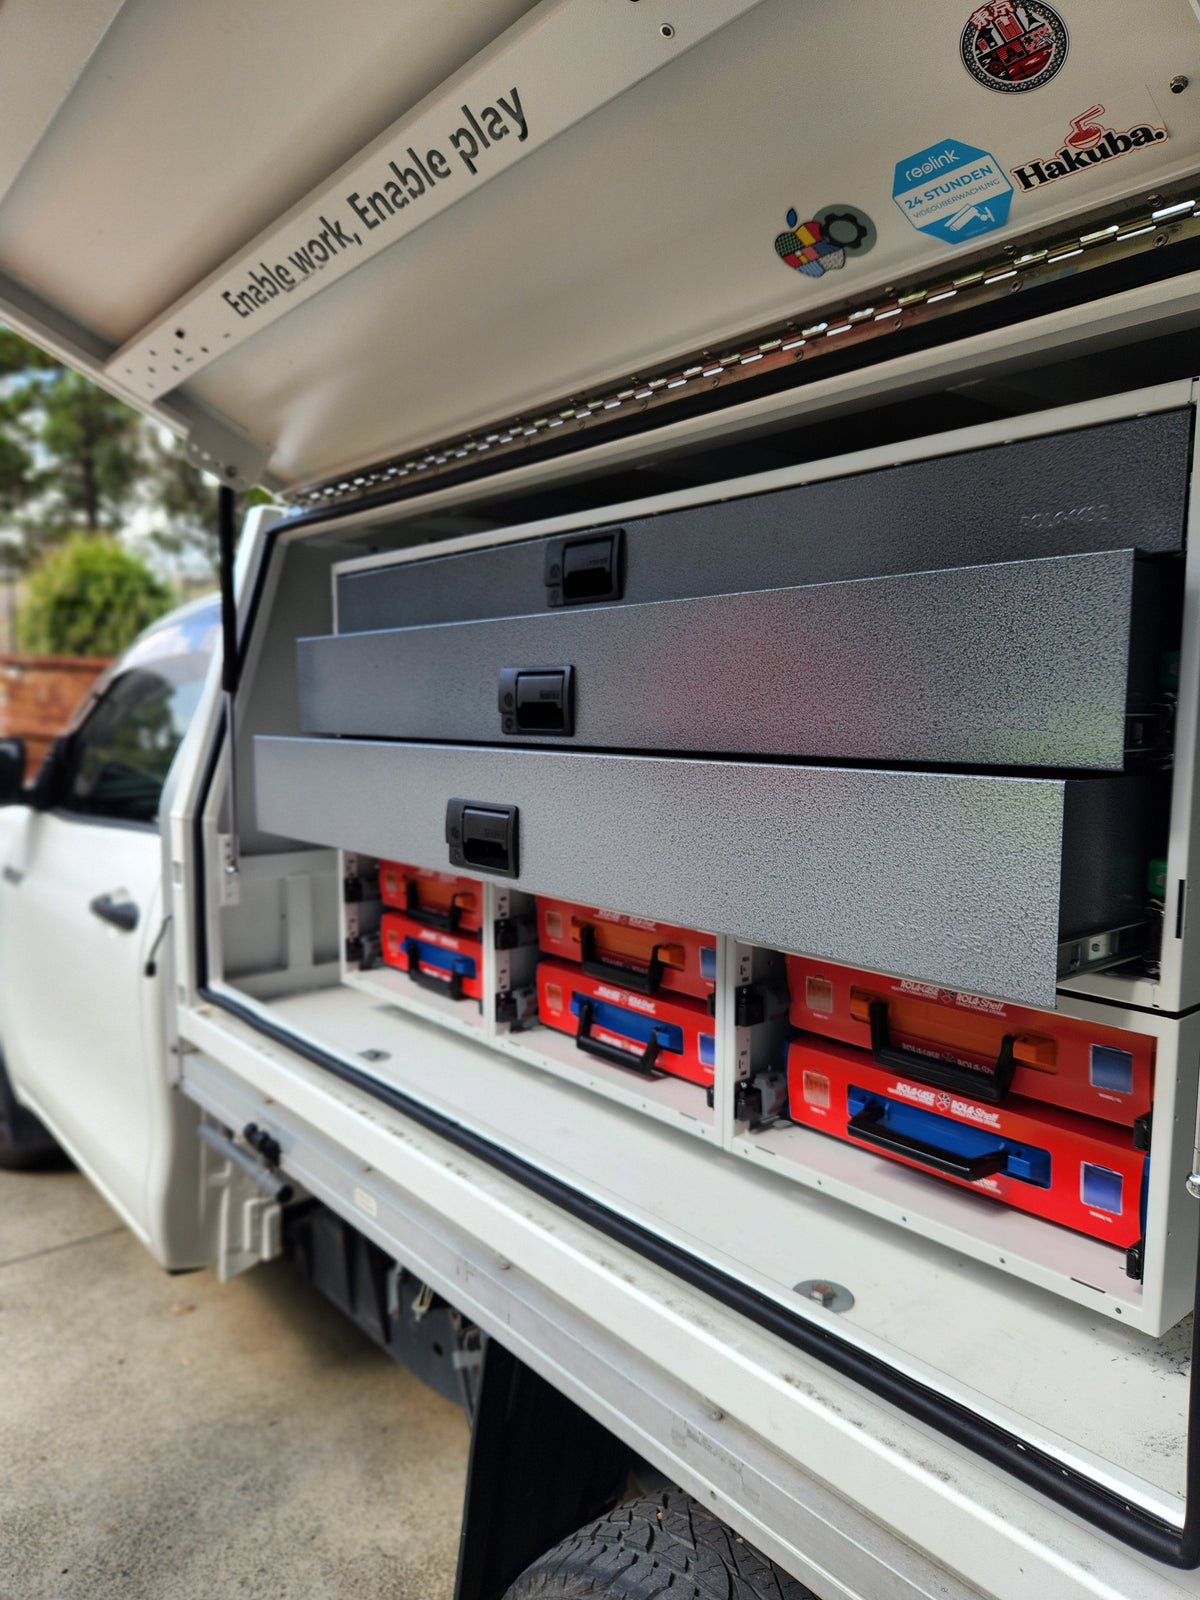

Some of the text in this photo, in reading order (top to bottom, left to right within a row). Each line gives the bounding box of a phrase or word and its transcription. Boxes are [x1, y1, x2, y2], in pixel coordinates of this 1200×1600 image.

[905, 149, 961, 182] reolink
[1013, 124, 1165, 191] Hakuba.
[221, 87, 529, 318] Enable work, Enable play
[904, 164, 994, 210] 24 STUNDEN
